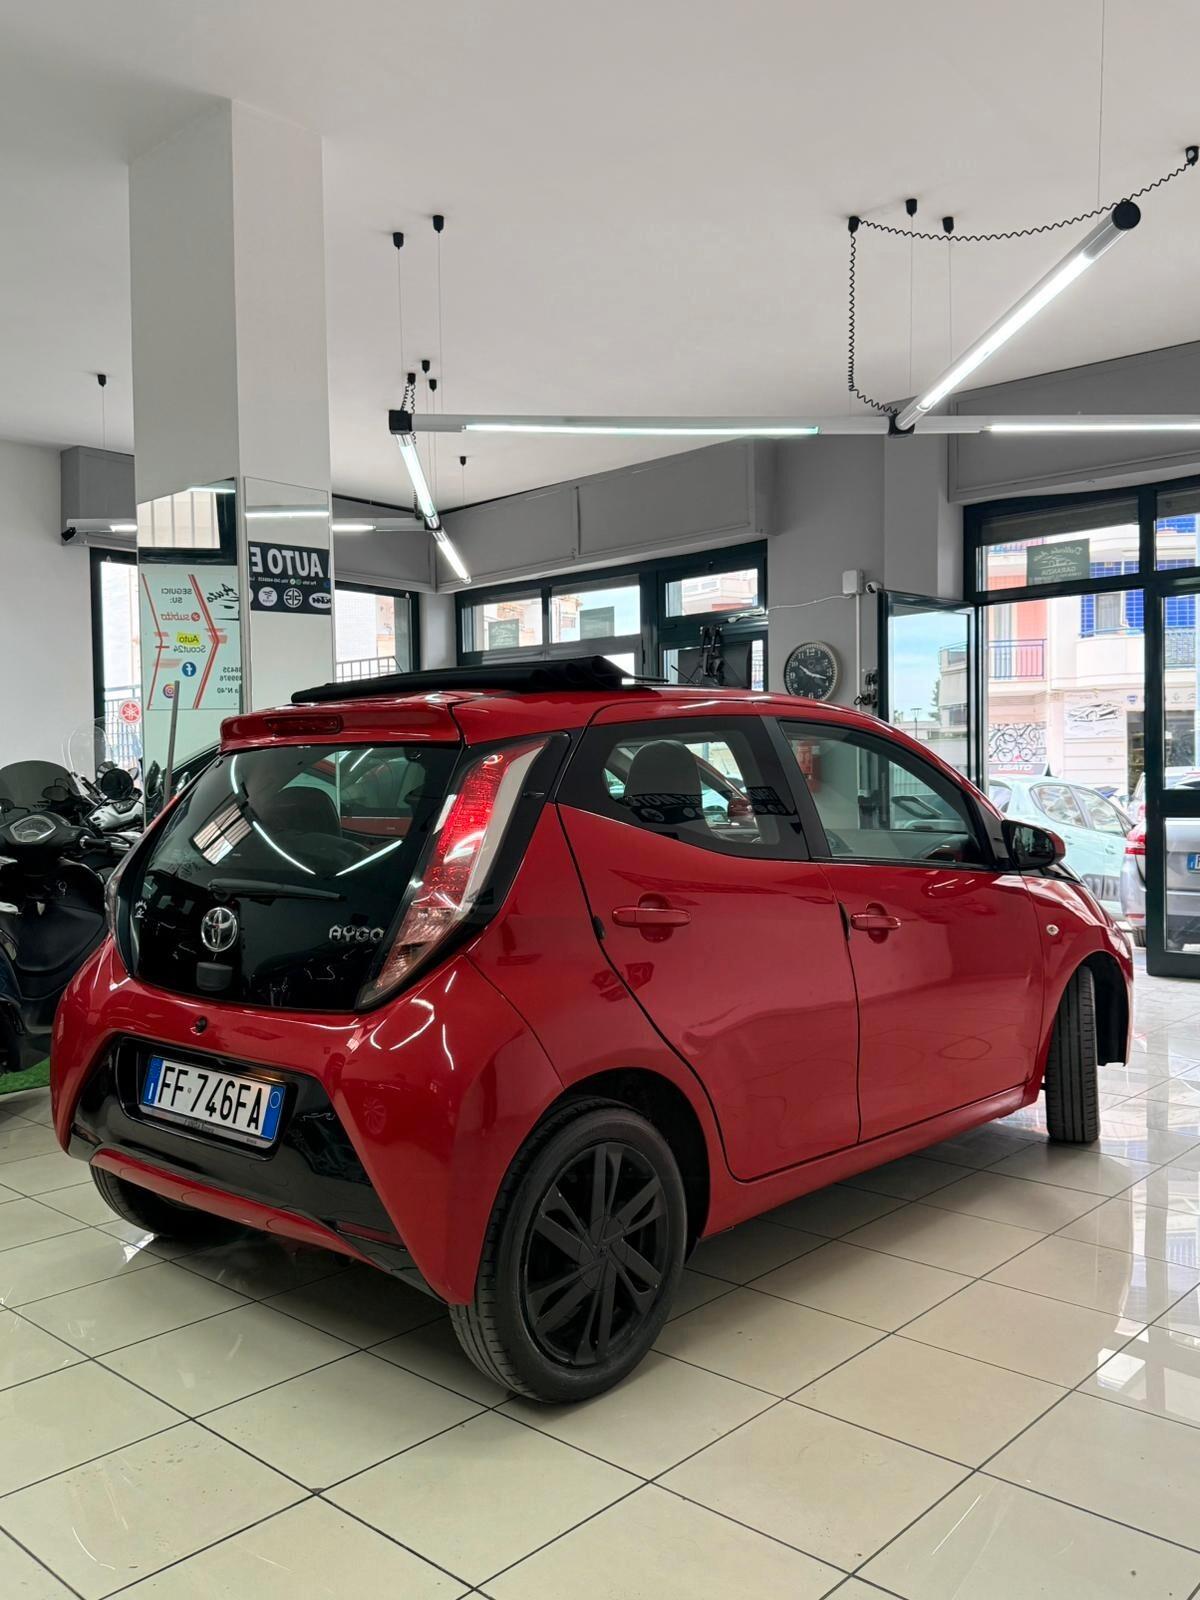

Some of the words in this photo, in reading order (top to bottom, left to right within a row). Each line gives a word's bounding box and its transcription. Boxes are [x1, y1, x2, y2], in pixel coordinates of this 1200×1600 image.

[329, 924, 384, 942] AYGO
[158, 1065, 189, 1107] FF
[190, 1073, 263, 1130] 746FA
